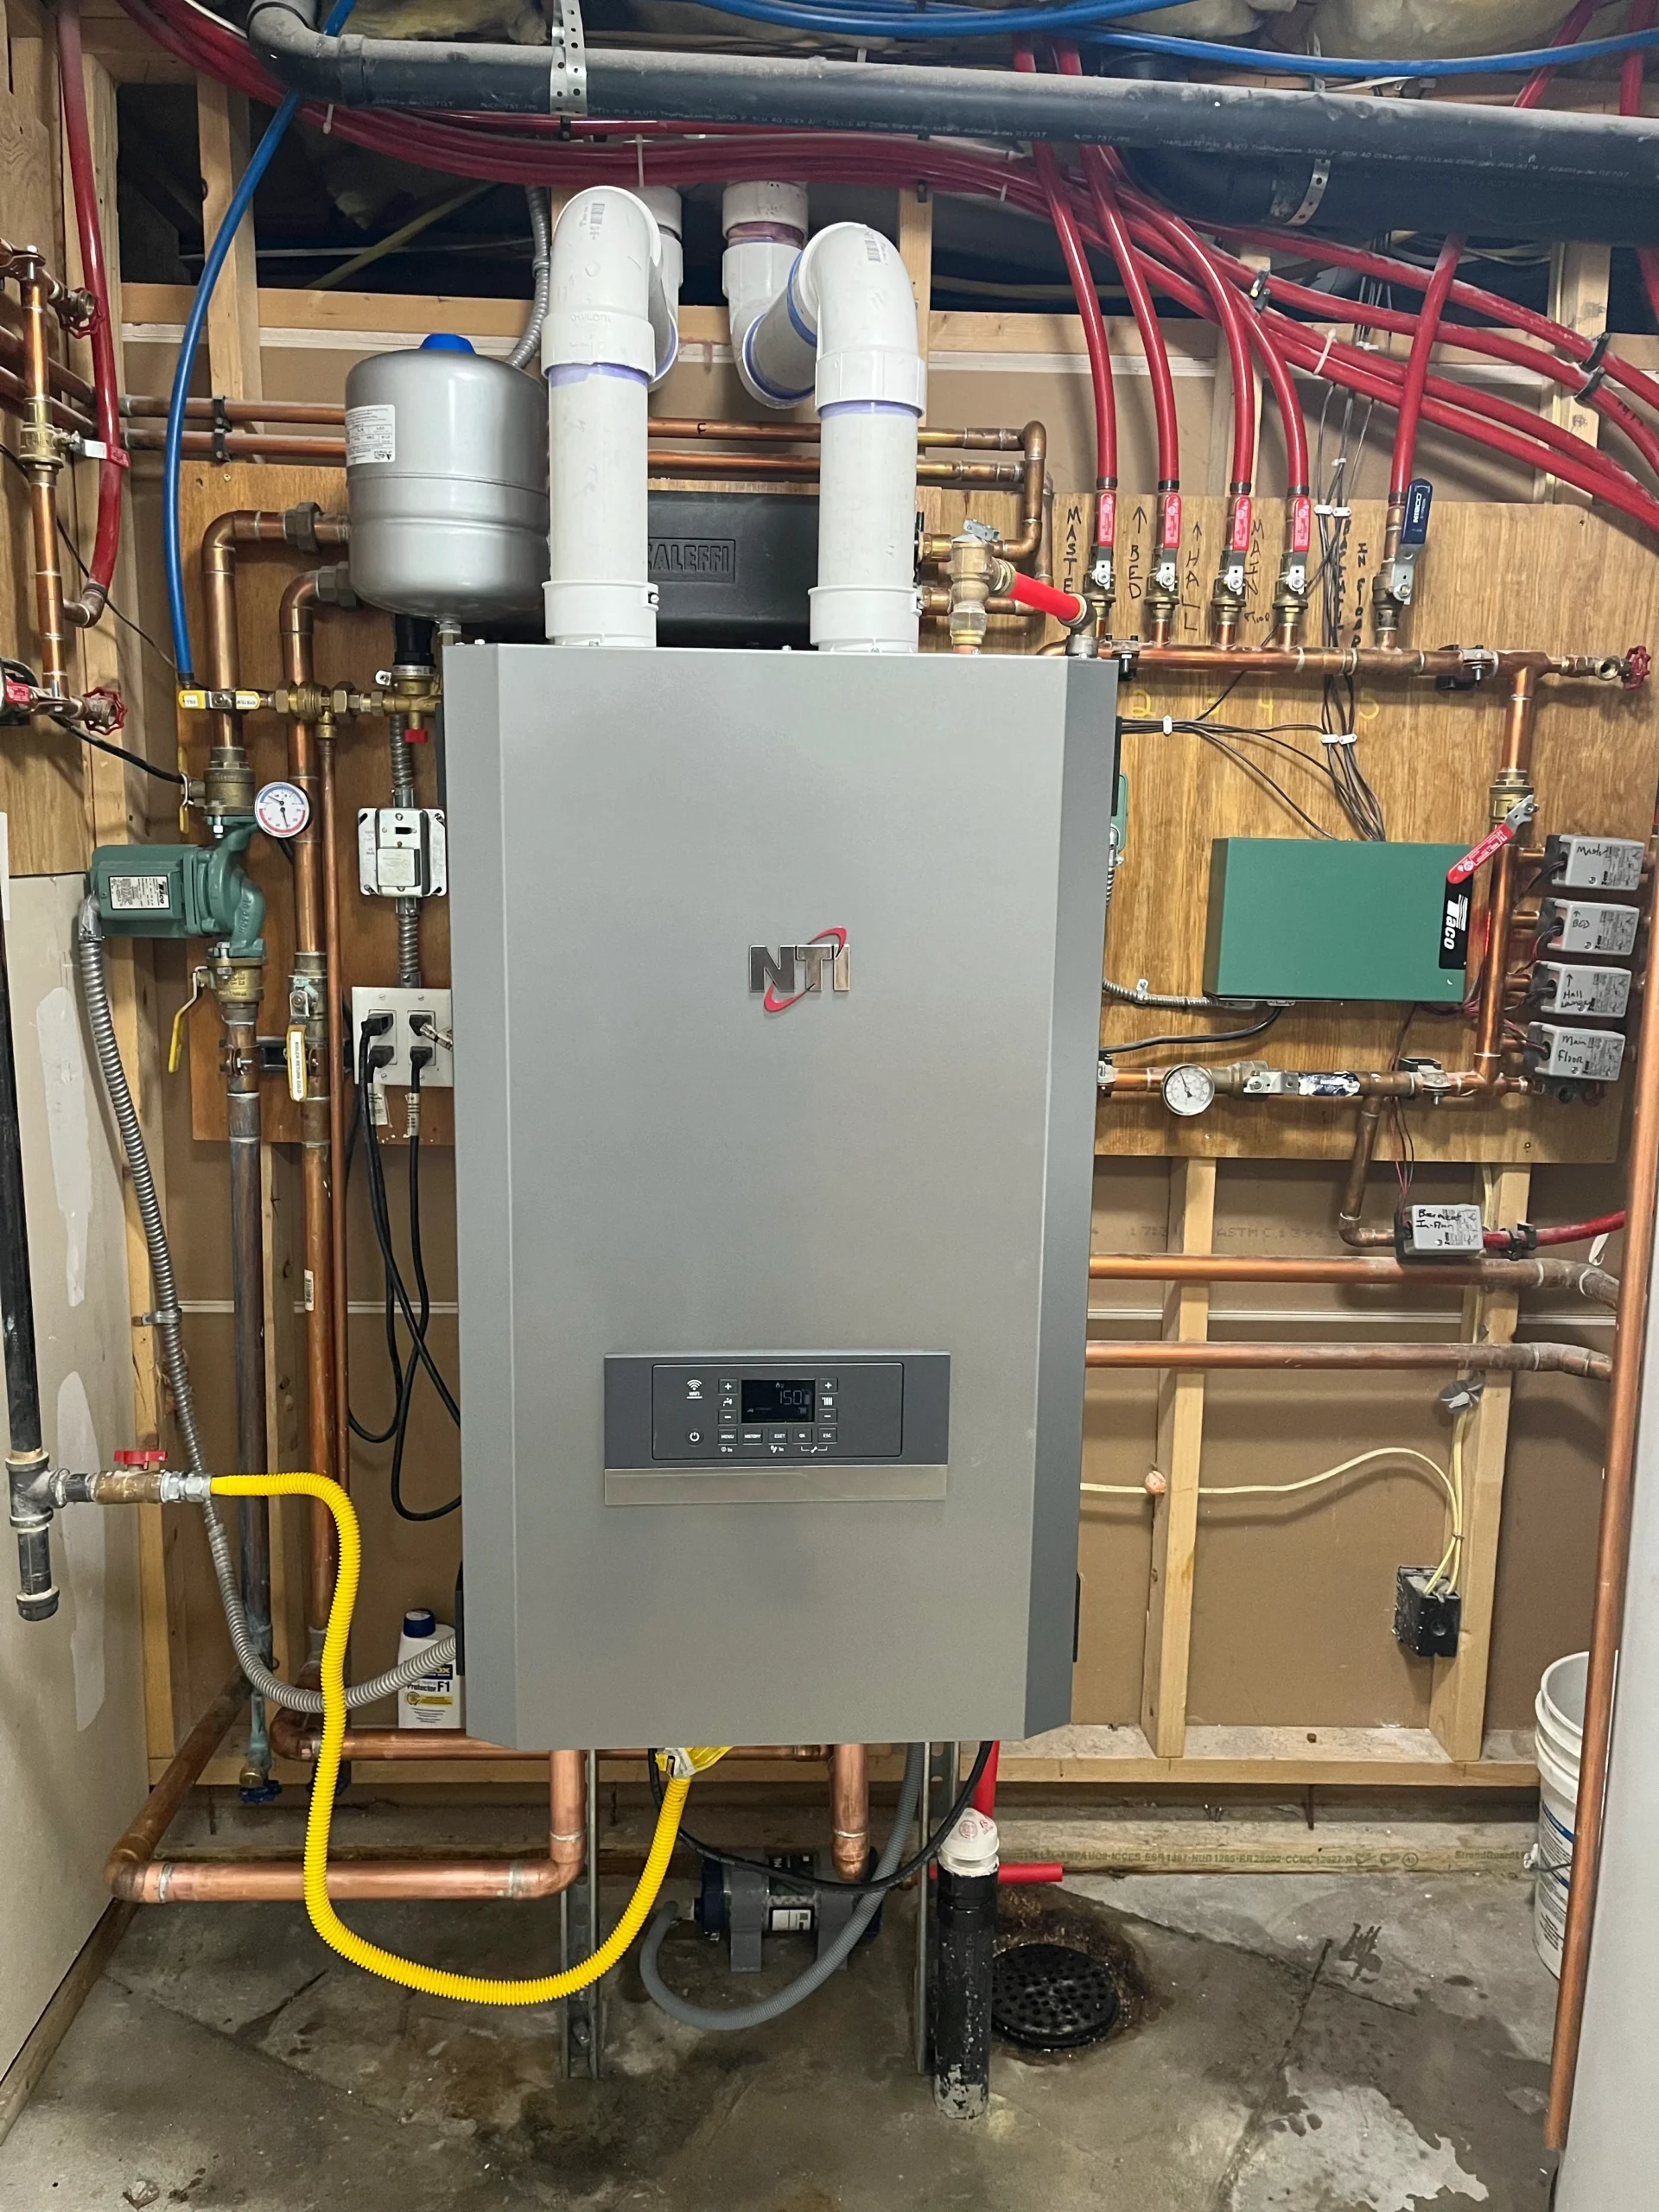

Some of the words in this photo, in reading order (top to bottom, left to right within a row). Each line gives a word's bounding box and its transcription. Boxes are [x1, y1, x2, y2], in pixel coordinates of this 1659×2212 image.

[1128, 544, 1143, 599] BED
[1181, 547, 1201, 632] HALL
[1129, 688, 1156, 718] 2
[1257, 687, 1274, 726] 4
[1443, 893, 1469, 950] Taco
[748, 944, 851, 994] NTI
[437, 1681, 450, 1693] F1
